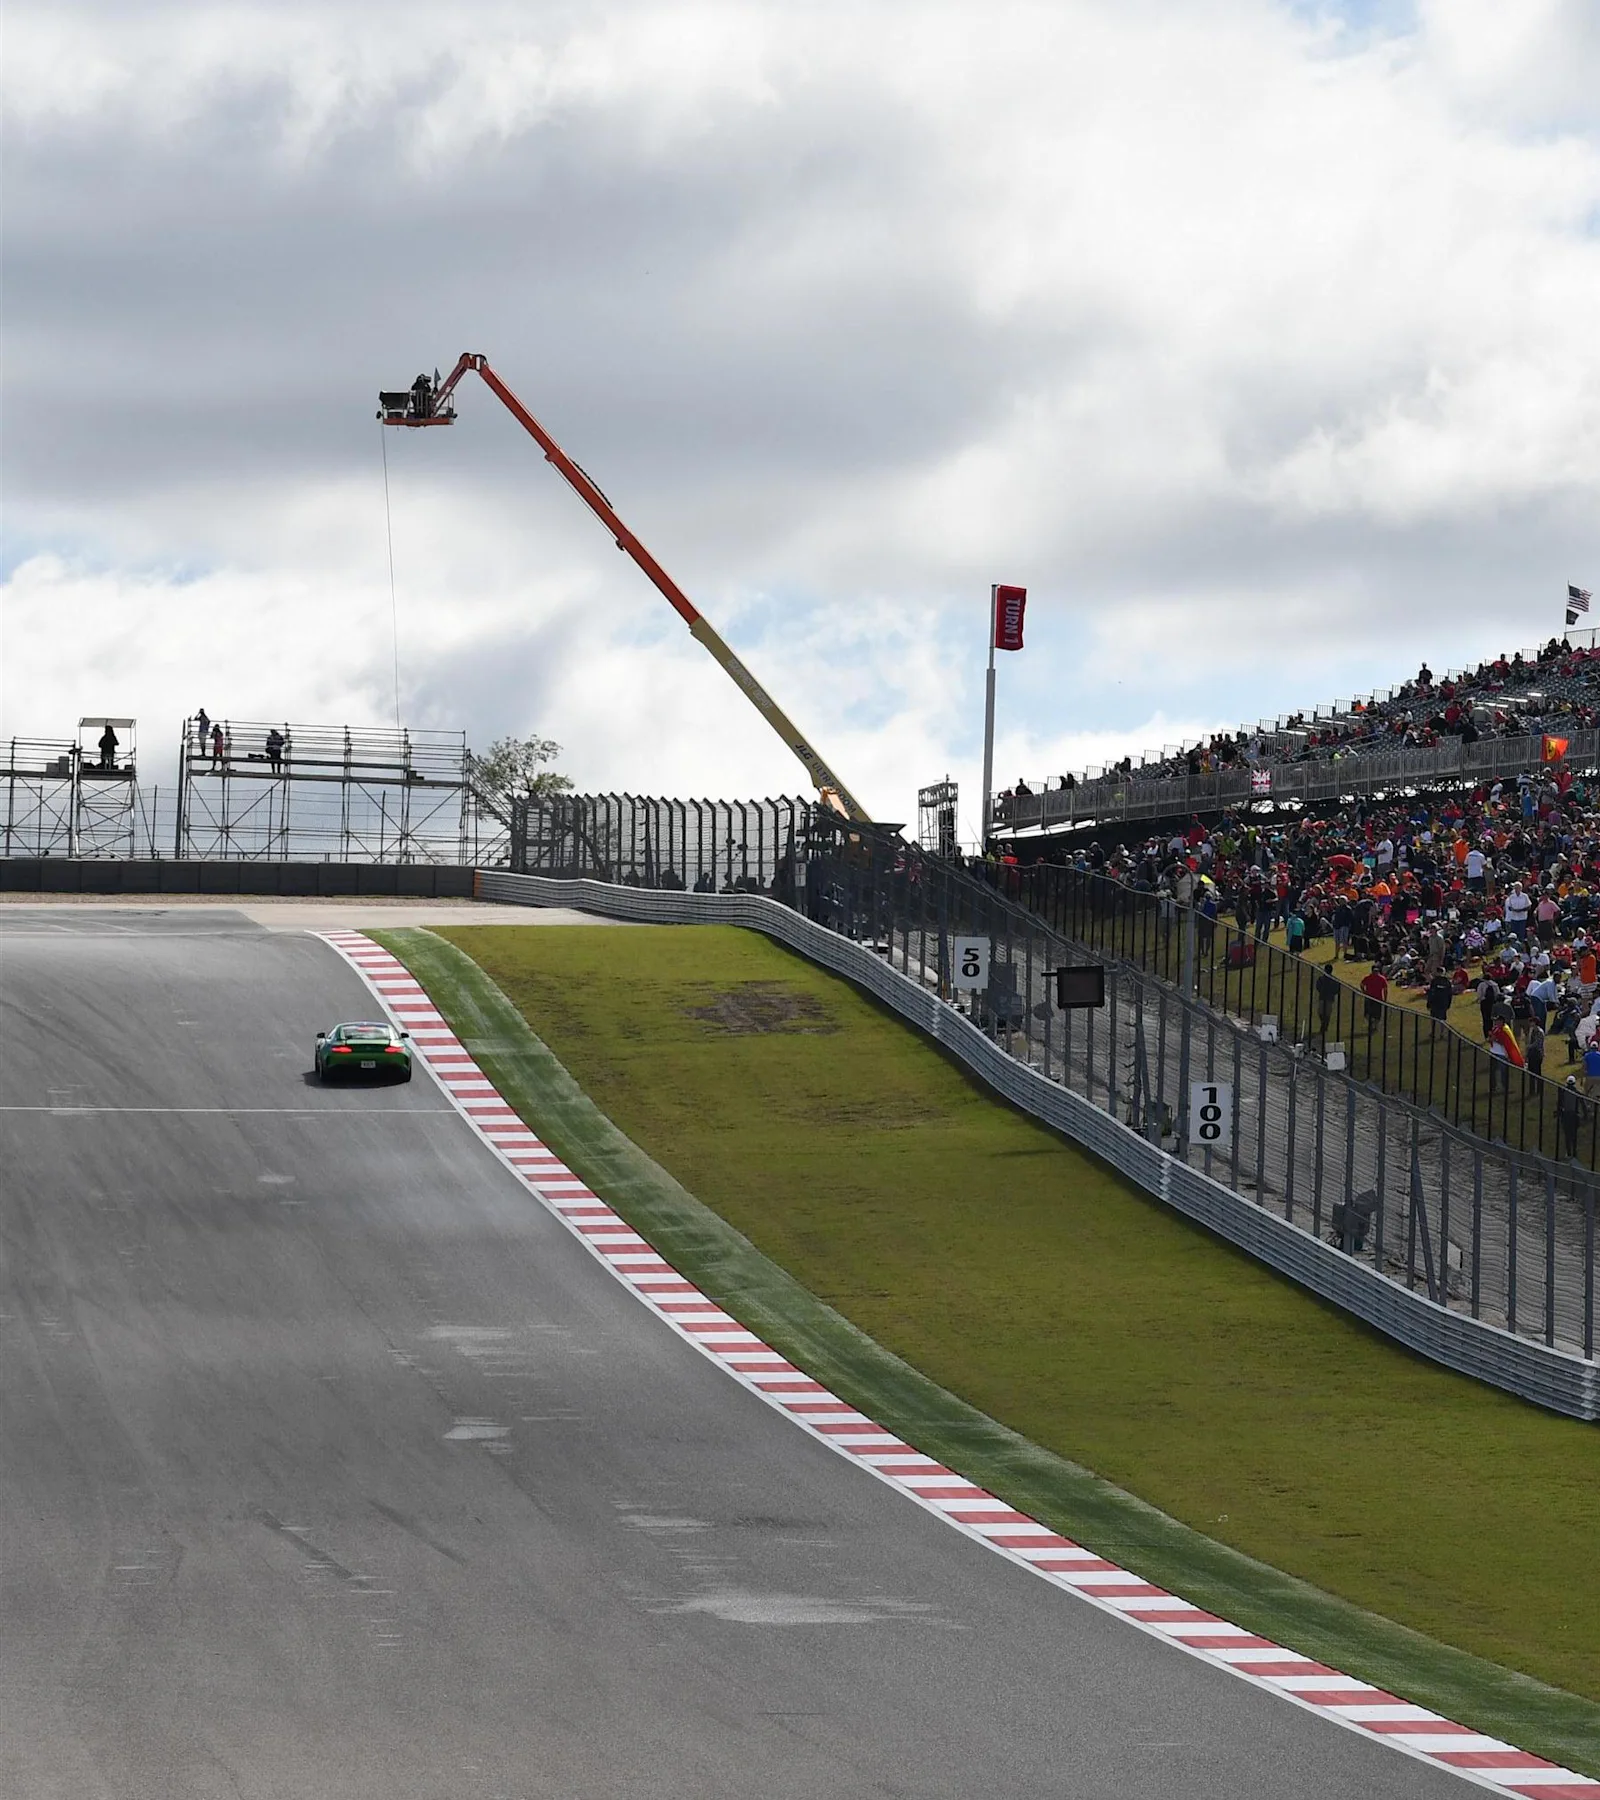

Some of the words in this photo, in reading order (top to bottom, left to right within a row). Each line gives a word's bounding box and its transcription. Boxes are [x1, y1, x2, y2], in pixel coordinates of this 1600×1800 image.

[1004, 598, 1021, 634] TURN
[1004, 636, 1019, 644] 1
[795, 743, 813, 760] JLG
[962, 947, 980, 978] 50
[1198, 1086, 1222, 1140] 100
